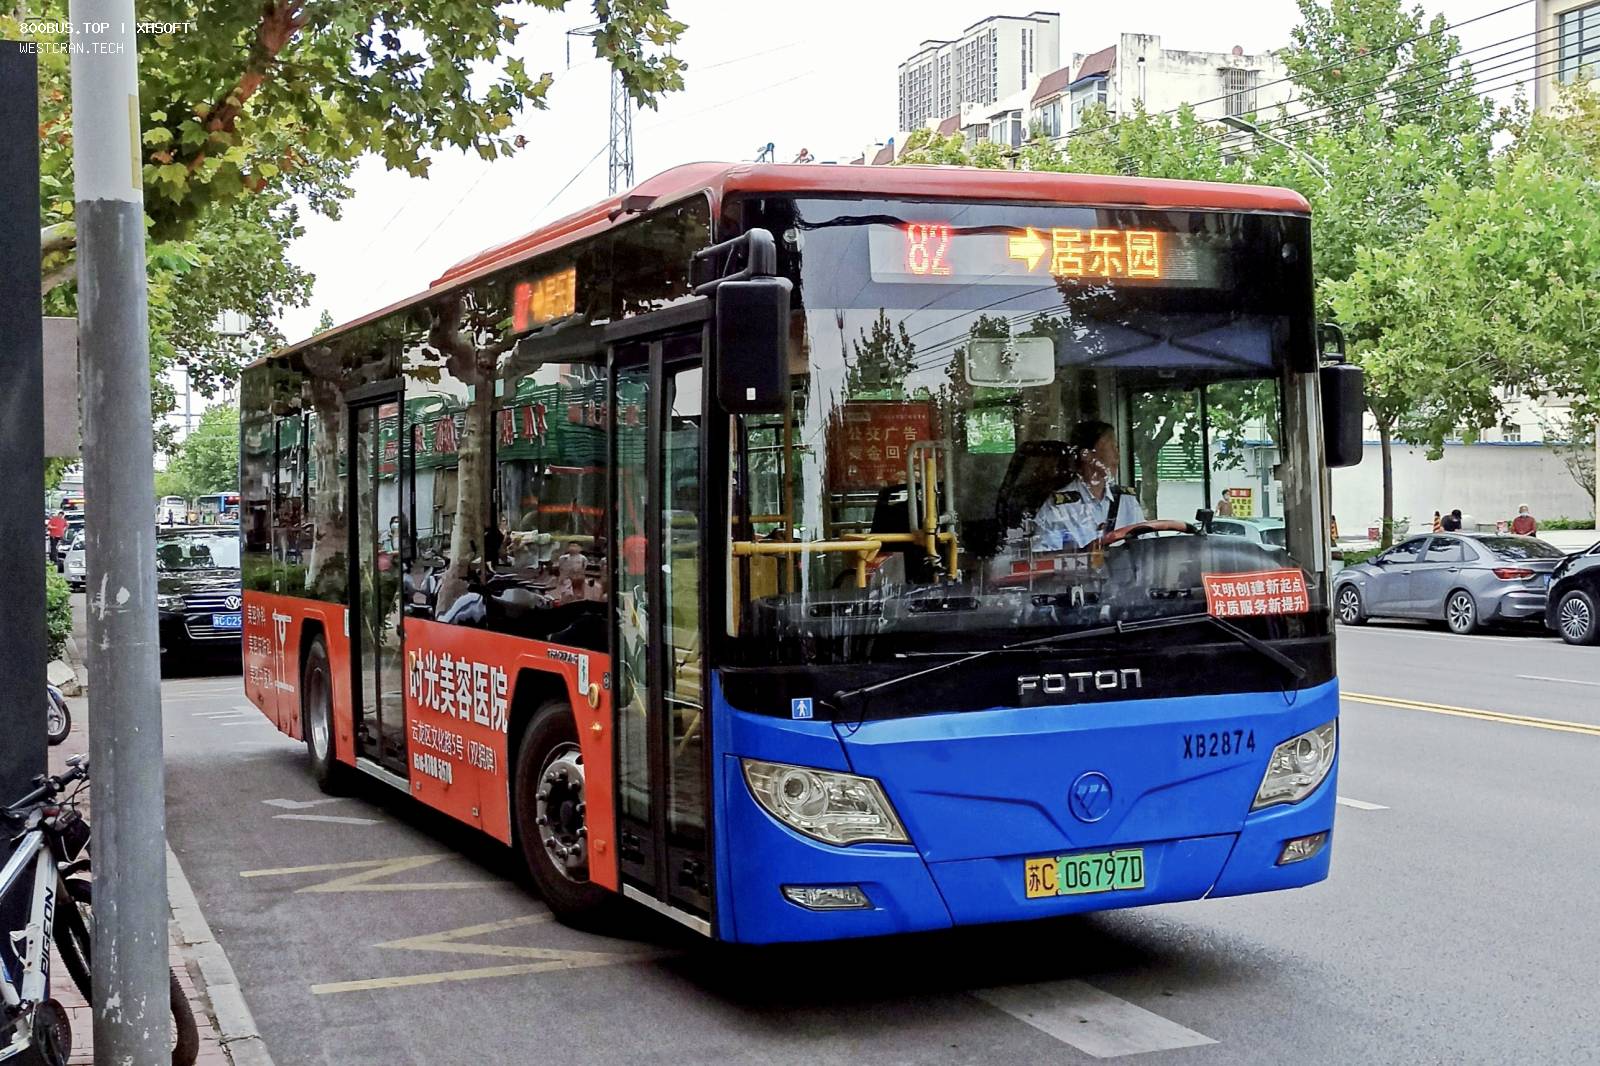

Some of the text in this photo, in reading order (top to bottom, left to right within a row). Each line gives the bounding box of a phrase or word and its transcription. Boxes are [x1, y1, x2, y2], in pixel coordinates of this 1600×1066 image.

[1049, 227, 1160, 278] 居乐园
[1210, 578, 1303, 597] 文明创建新起点
[1214, 596, 1305, 616] 优质服务新提升
[408, 647, 509, 734] 时光美容医院
[1017, 668, 1143, 696] FOTON
[1183, 730, 1257, 760] XB2874
[40, 886, 54, 977] PIGEON
